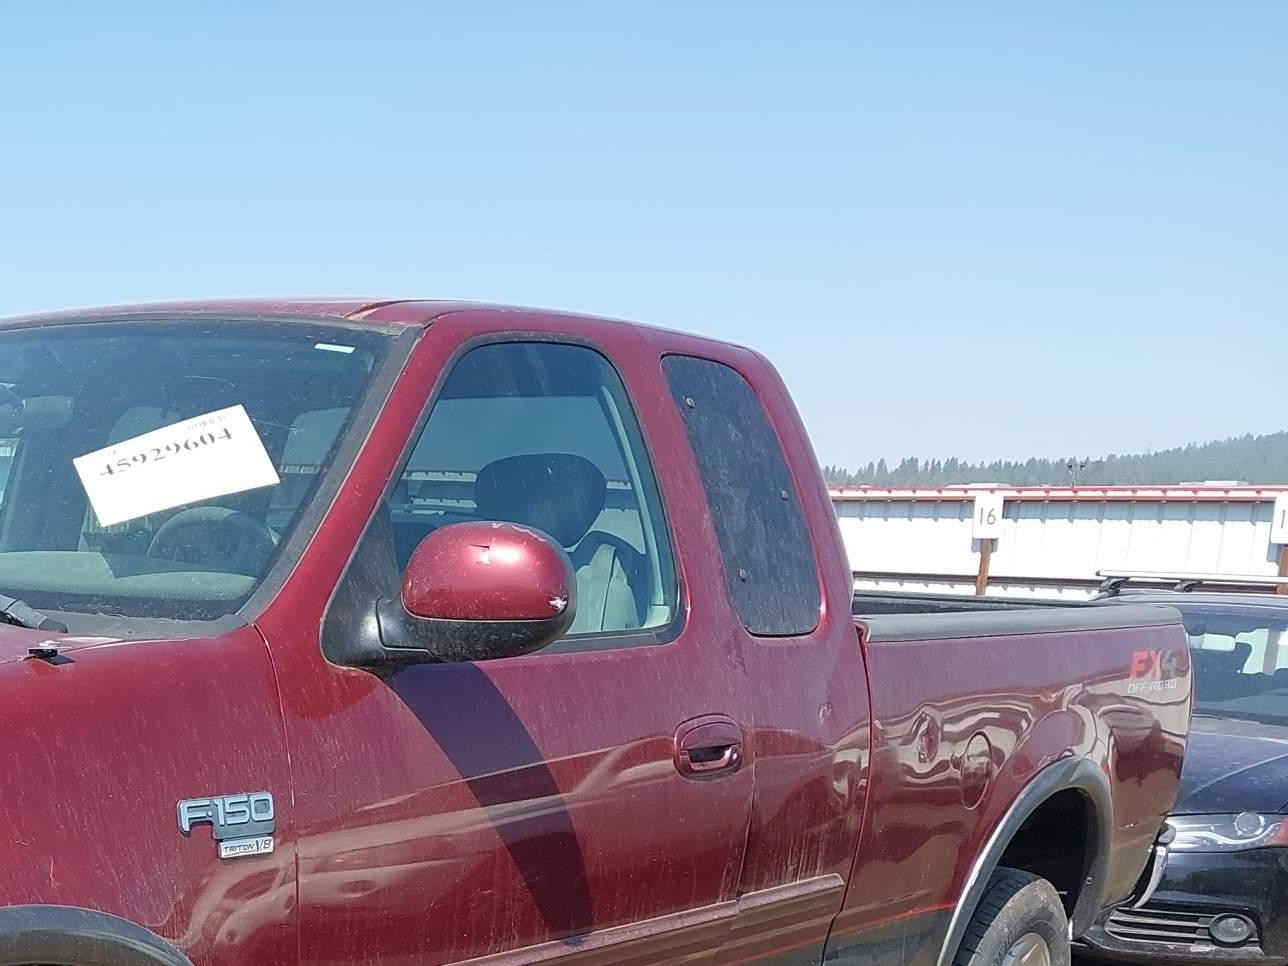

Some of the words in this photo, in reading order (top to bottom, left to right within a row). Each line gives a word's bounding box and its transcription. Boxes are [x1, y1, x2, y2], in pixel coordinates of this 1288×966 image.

[100, 426, 233, 477] 45929604
[979, 506, 996, 525] 16
[1129, 649, 1177, 679] FX4
[1127, 680, 1150, 694] OFF
[1151, 679, 1177, 690] ROAD
[223, 843, 255, 853] TRITON
[255, 839, 272, 852] V8
